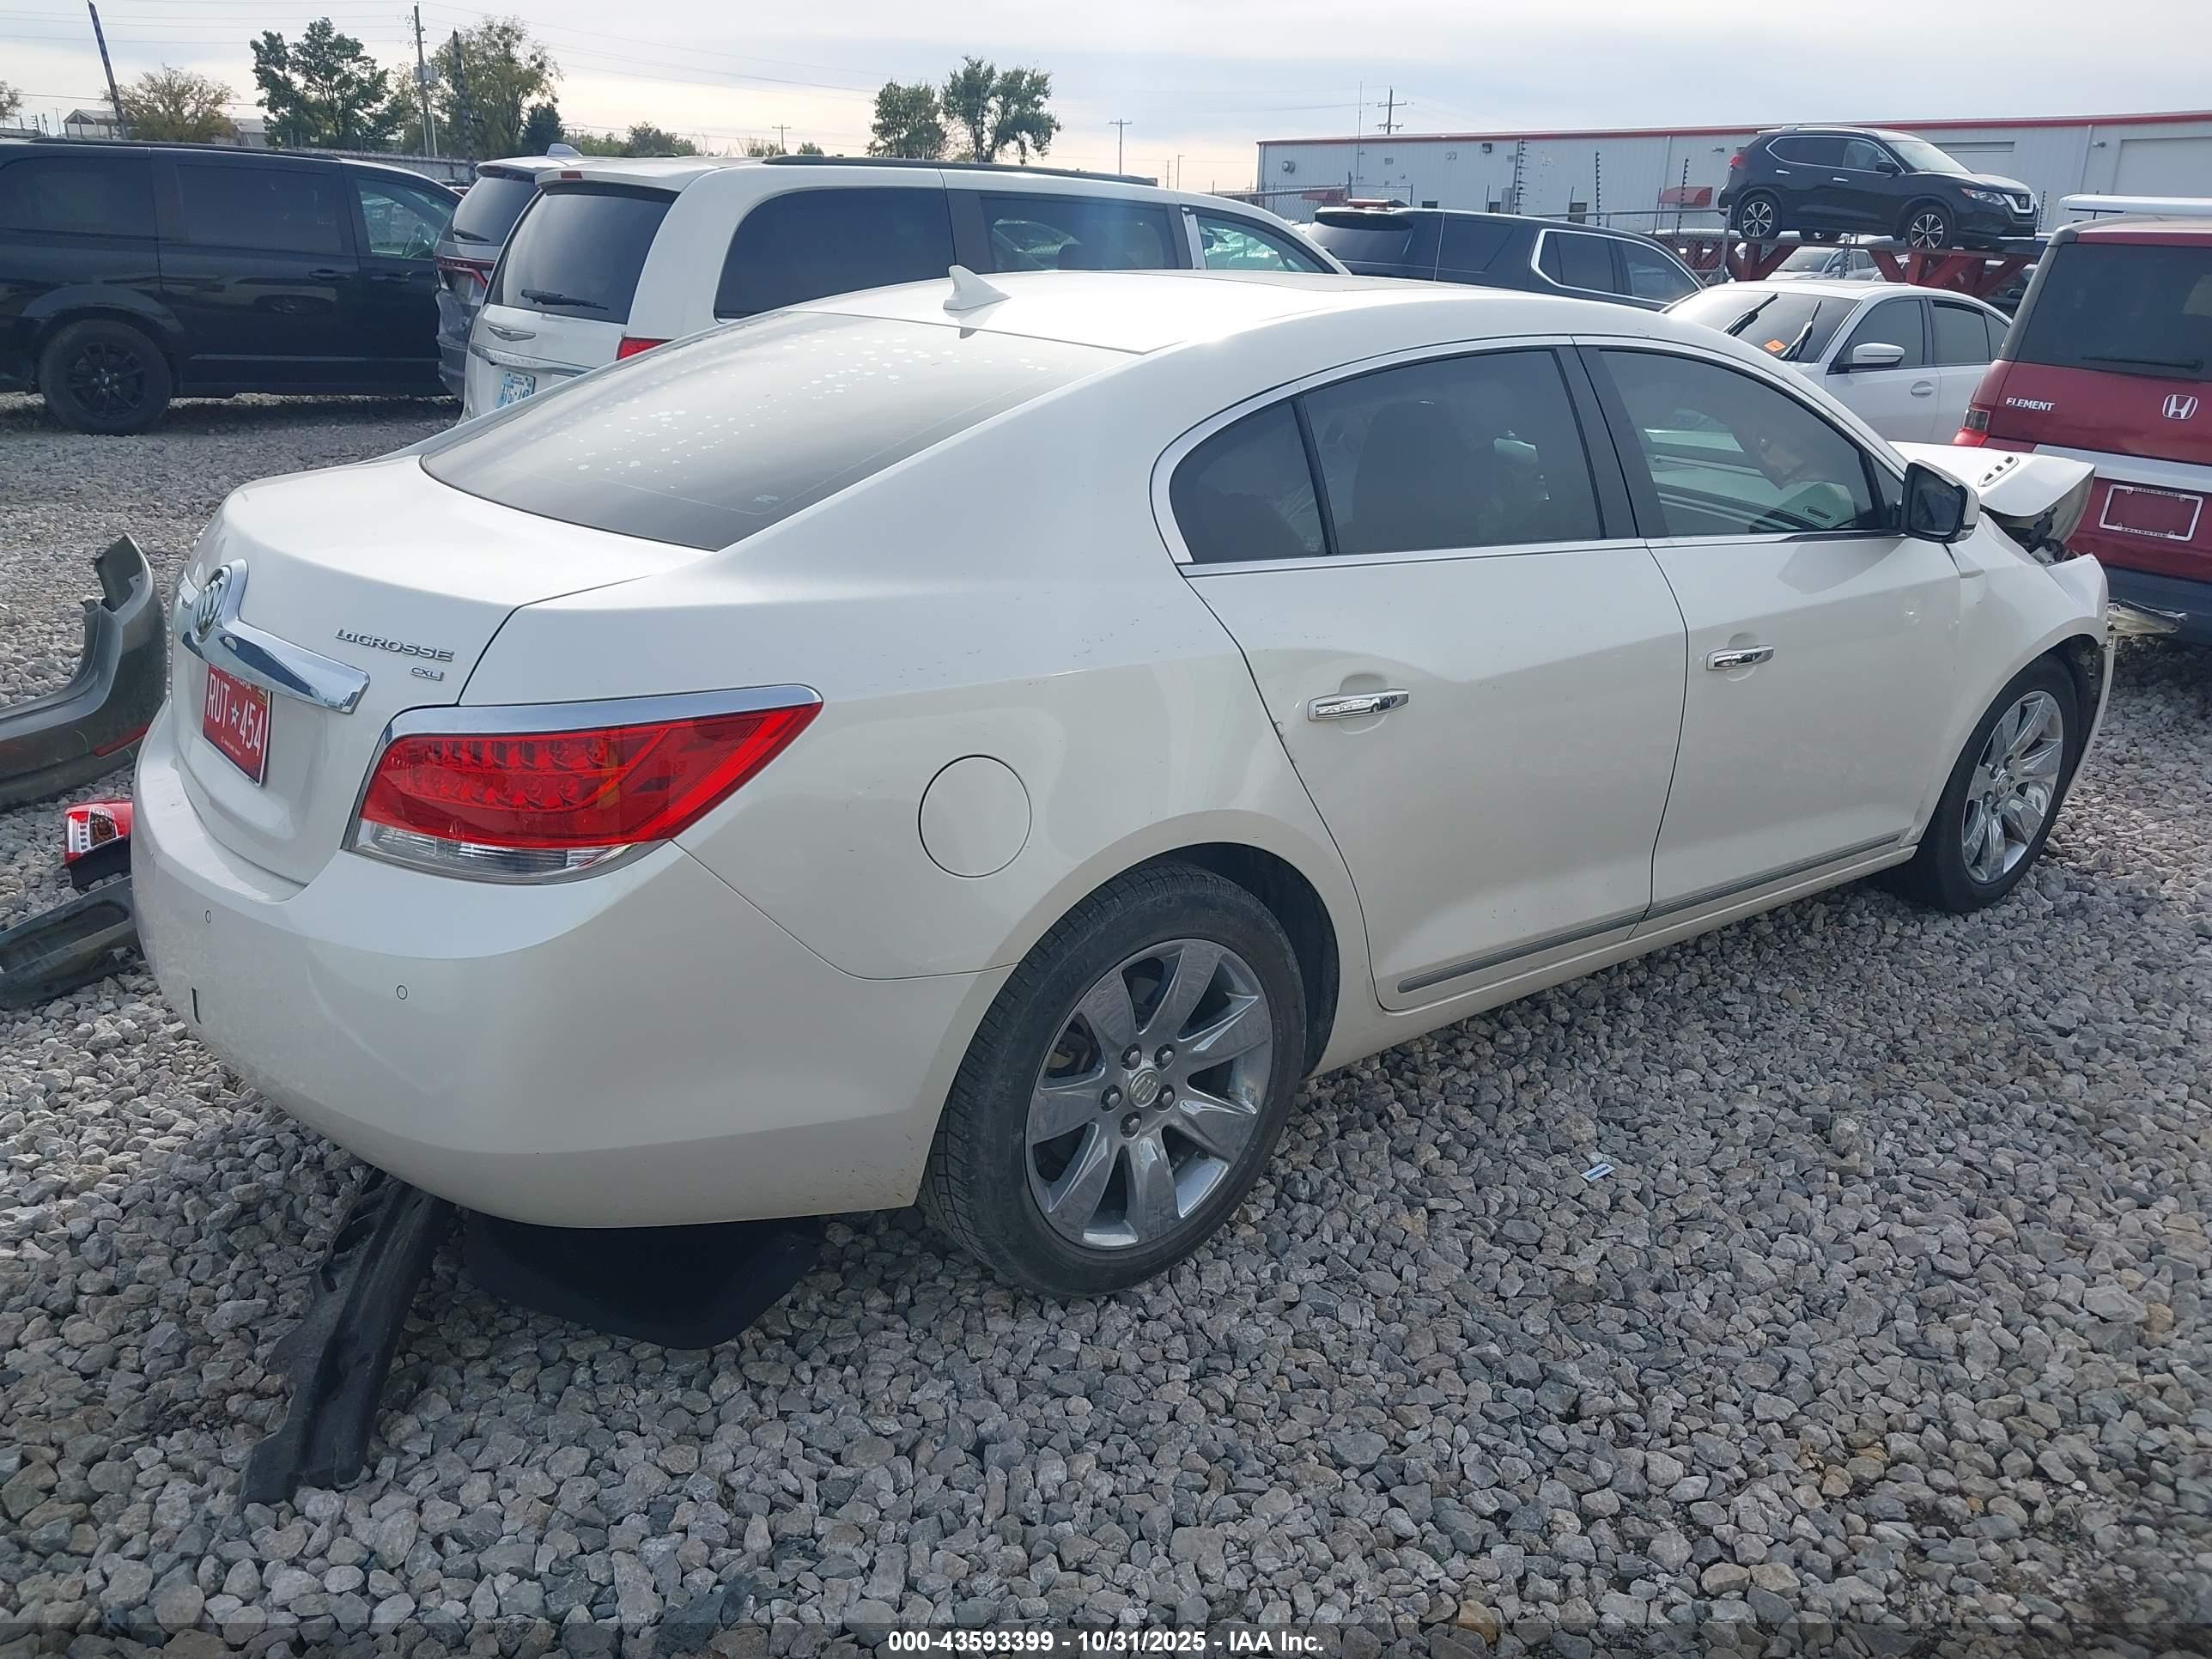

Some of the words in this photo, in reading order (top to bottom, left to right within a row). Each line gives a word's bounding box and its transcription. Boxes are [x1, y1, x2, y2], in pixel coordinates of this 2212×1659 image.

[2005, 397, 2055, 410] ELEMENT
[411, 666, 440, 679] CXL
[207, 672, 230, 728] RUT
[239, 698, 264, 757] 454
